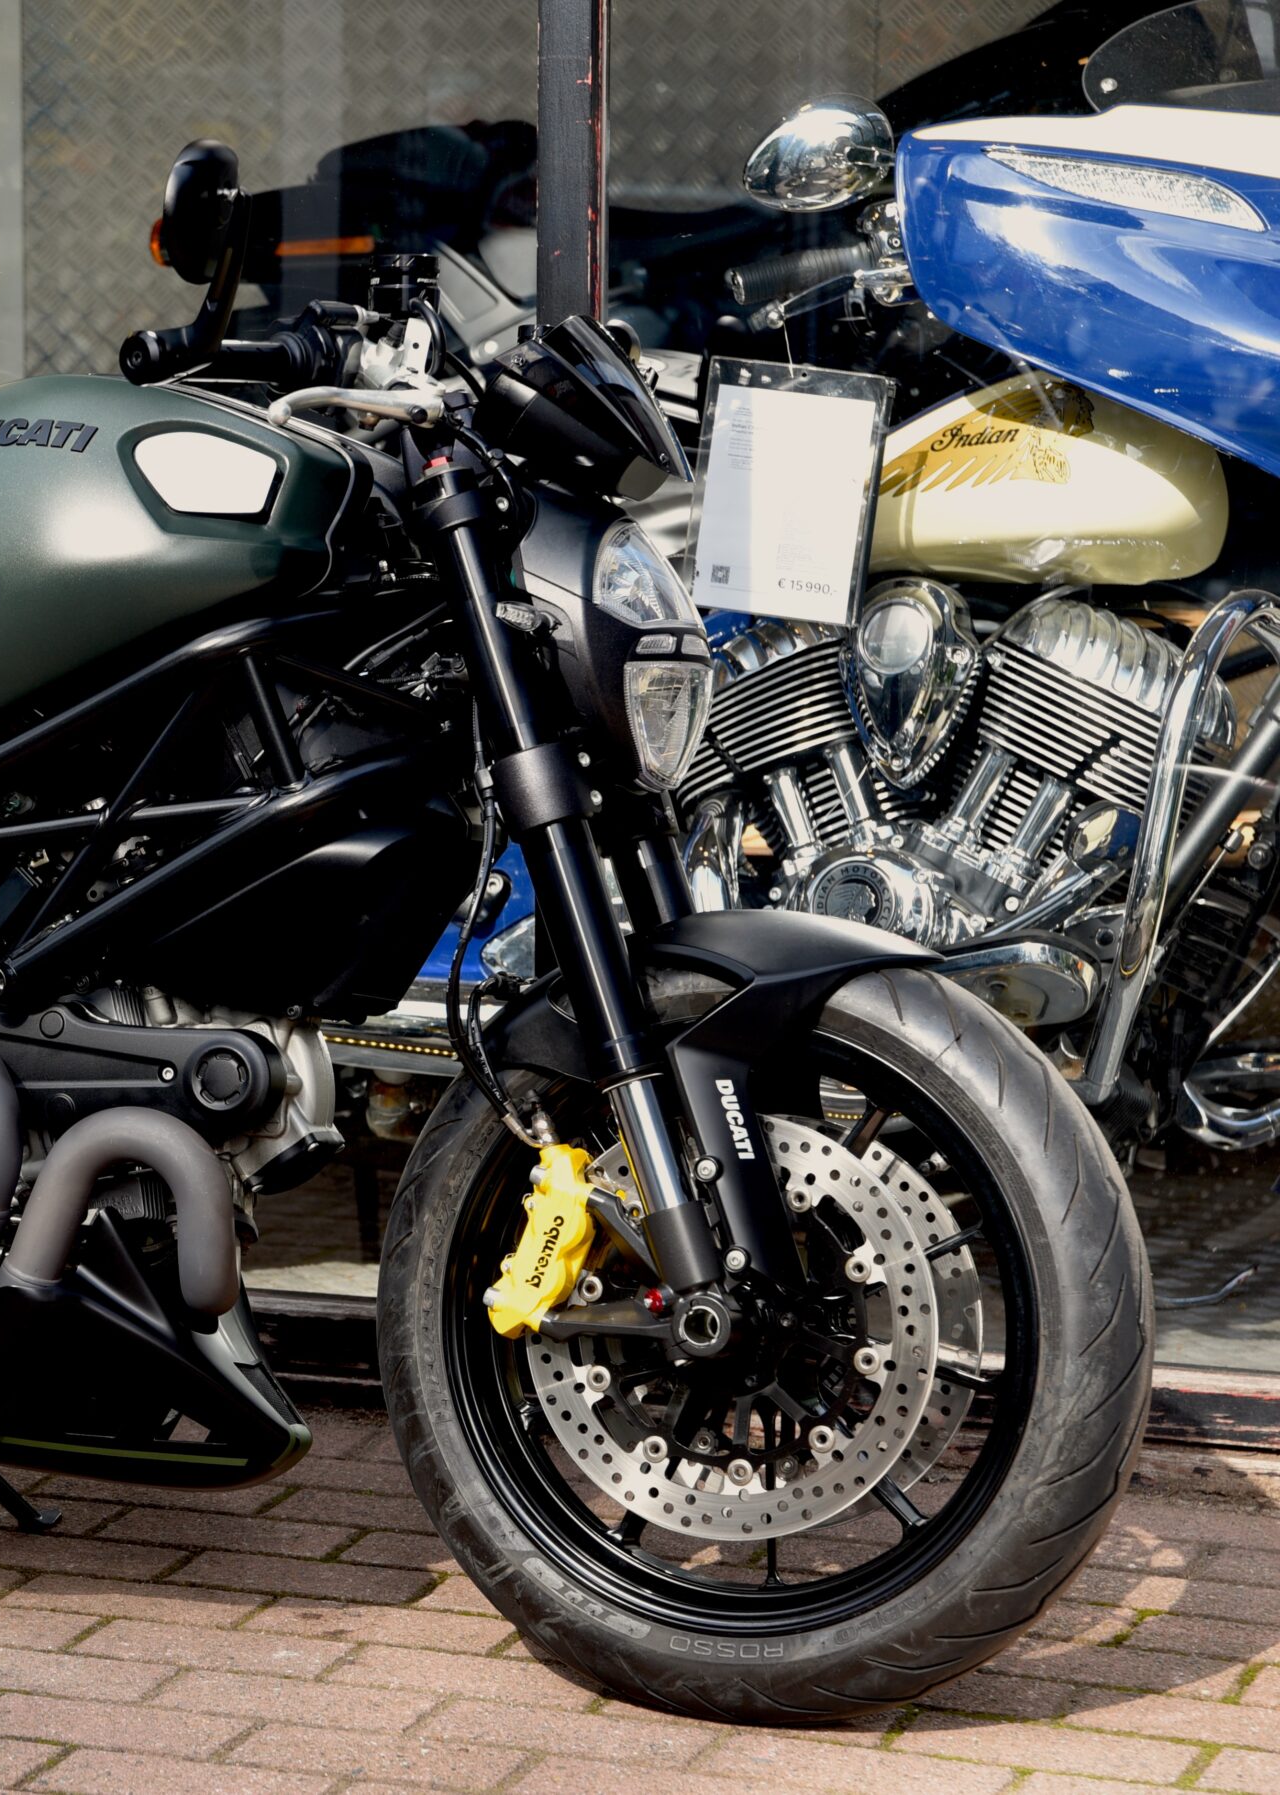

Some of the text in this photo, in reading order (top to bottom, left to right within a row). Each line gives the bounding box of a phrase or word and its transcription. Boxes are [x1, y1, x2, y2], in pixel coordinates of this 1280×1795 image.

[930, 423, 1020, 452] Indian
[715, 1079, 755, 1159] DUCATI
[525, 1215, 565, 1289] brembo
[670, 1635, 784, 1658] ROSSO
